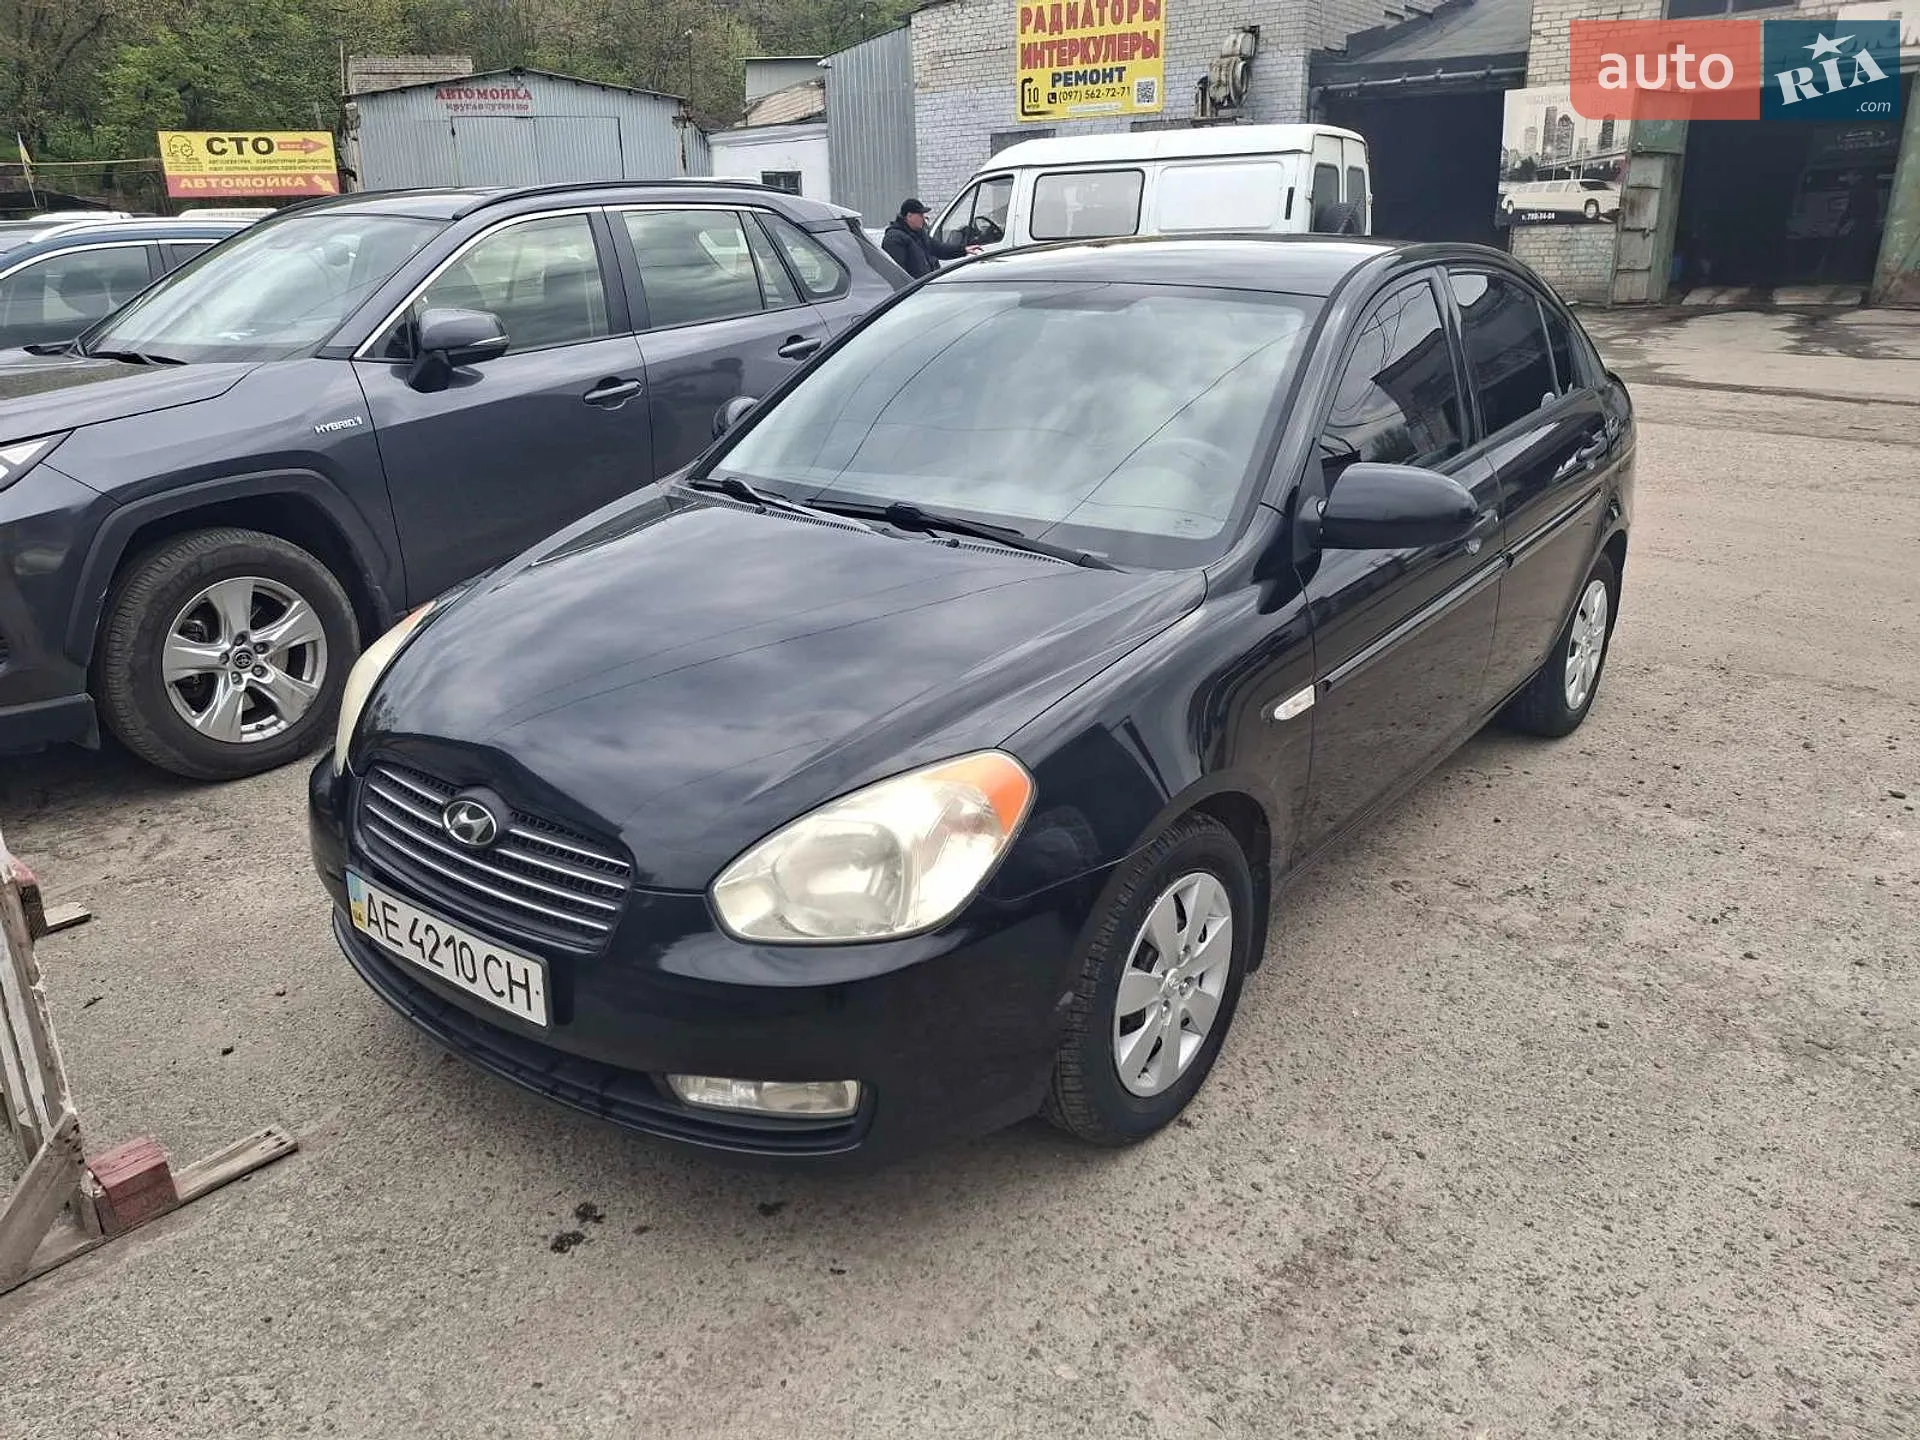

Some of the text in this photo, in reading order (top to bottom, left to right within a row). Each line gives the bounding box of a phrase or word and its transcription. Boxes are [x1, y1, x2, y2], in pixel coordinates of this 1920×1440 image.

[1020, 0, 1161, 36] РАДИАТОРЫ
[1020, 29, 1160, 70] ИНТЕРКУЛЕРЫ
[1051, 66, 1126, 88] РЕМОНТ
[435, 86, 532, 100] АВТОМОЙКА
[1027, 87, 1039, 103] 10
[1059, 86, 1131, 104] (097) 562-72-71
[206, 137, 275, 155] СТО
[179, 175, 307, 189] АВТОМОЙКА
[314, 417, 359, 433] HYBRID
[367, 893, 532, 1011] AE 4210 CH
